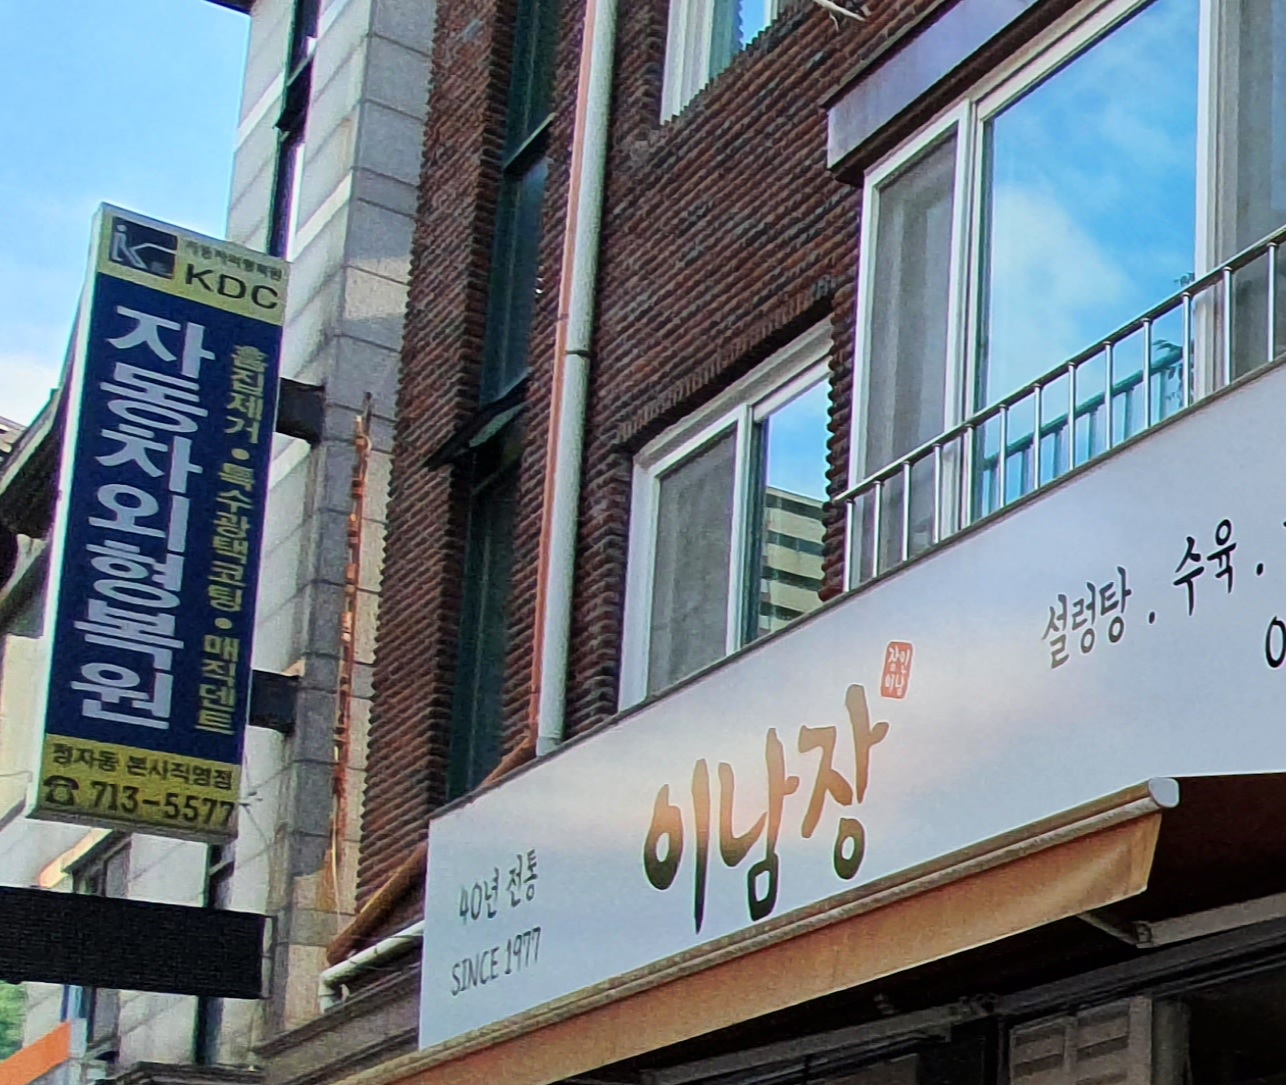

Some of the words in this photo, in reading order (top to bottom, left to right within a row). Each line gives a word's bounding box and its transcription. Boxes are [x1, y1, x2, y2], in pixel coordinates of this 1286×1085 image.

[185, 263, 279, 309] KDC
[224, 344, 269, 444] 흠집제거
[70, 304, 216, 730] 자동차외형복원
[207, 462, 256, 613] 특수광택코팅
[1042, 567, 1132, 669] 설렁탕
[1173, 518, 1237, 616] 수육
[195, 633, 240, 735] 매직덴트
[52, 743, 119, 772] 정자동
[126, 755, 232, 790] 본사직영점
[91, 780, 236, 827] 713-5577
[643, 683, 888, 934] 이남장
[459, 866, 499, 924] 40년
[506, 849, 538, 907] 전통
[451, 946, 499, 996] SINCE
[504, 926, 541, 975] 1977
